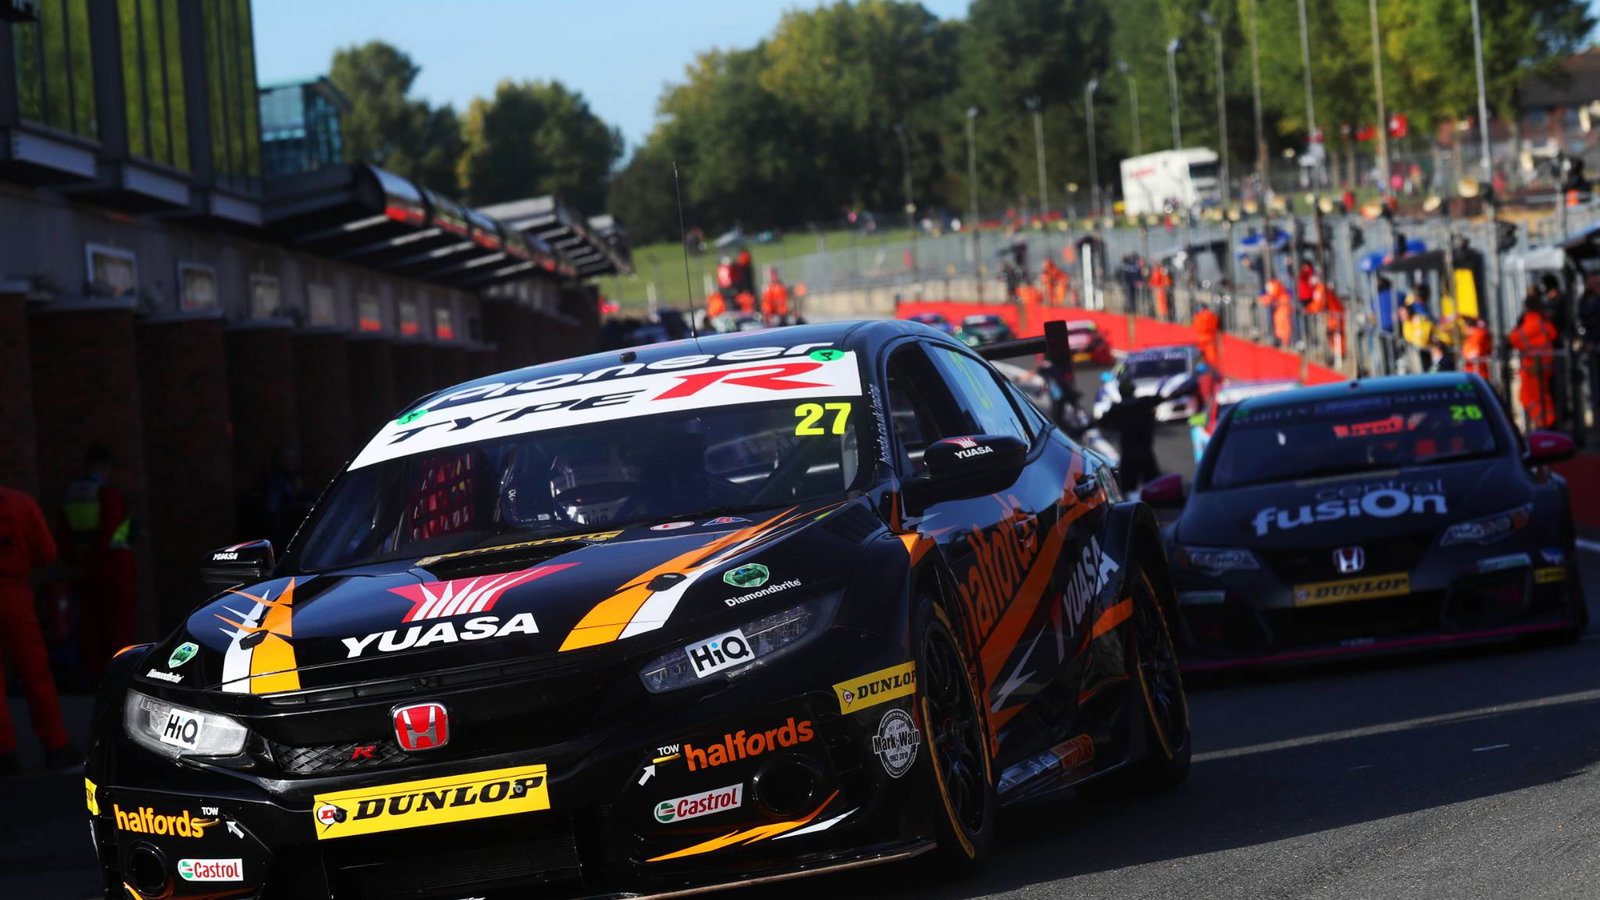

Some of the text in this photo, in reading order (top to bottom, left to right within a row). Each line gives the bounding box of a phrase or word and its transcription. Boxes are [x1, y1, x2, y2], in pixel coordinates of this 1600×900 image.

[387, 362, 836, 446] TYPE R
[794, 402, 852, 436] 27
[954, 445, 994, 460] YUASA
[1315, 478, 1444, 500] central
[212, 552, 239, 561] YUASA
[725, 578, 802, 608] Diamondbrite
[1063, 535, 1121, 638] YUASA
[1313, 577, 1408, 599] DUNLOP
[340, 613, 540, 659] YUASA
[690, 636, 751, 672] HiQ
[164, 713, 199, 745] HiQ
[684, 717, 815, 772] halfords
[874, 730, 920, 753] Mark Wain
[657, 744, 680, 756] TOW
[201, 806, 219, 816] TOW
[352, 776, 544, 821] DUNLOP
[677, 787, 738, 818] Castrol
[113, 804, 204, 839] halfords
[193, 861, 240, 879] Castrol
